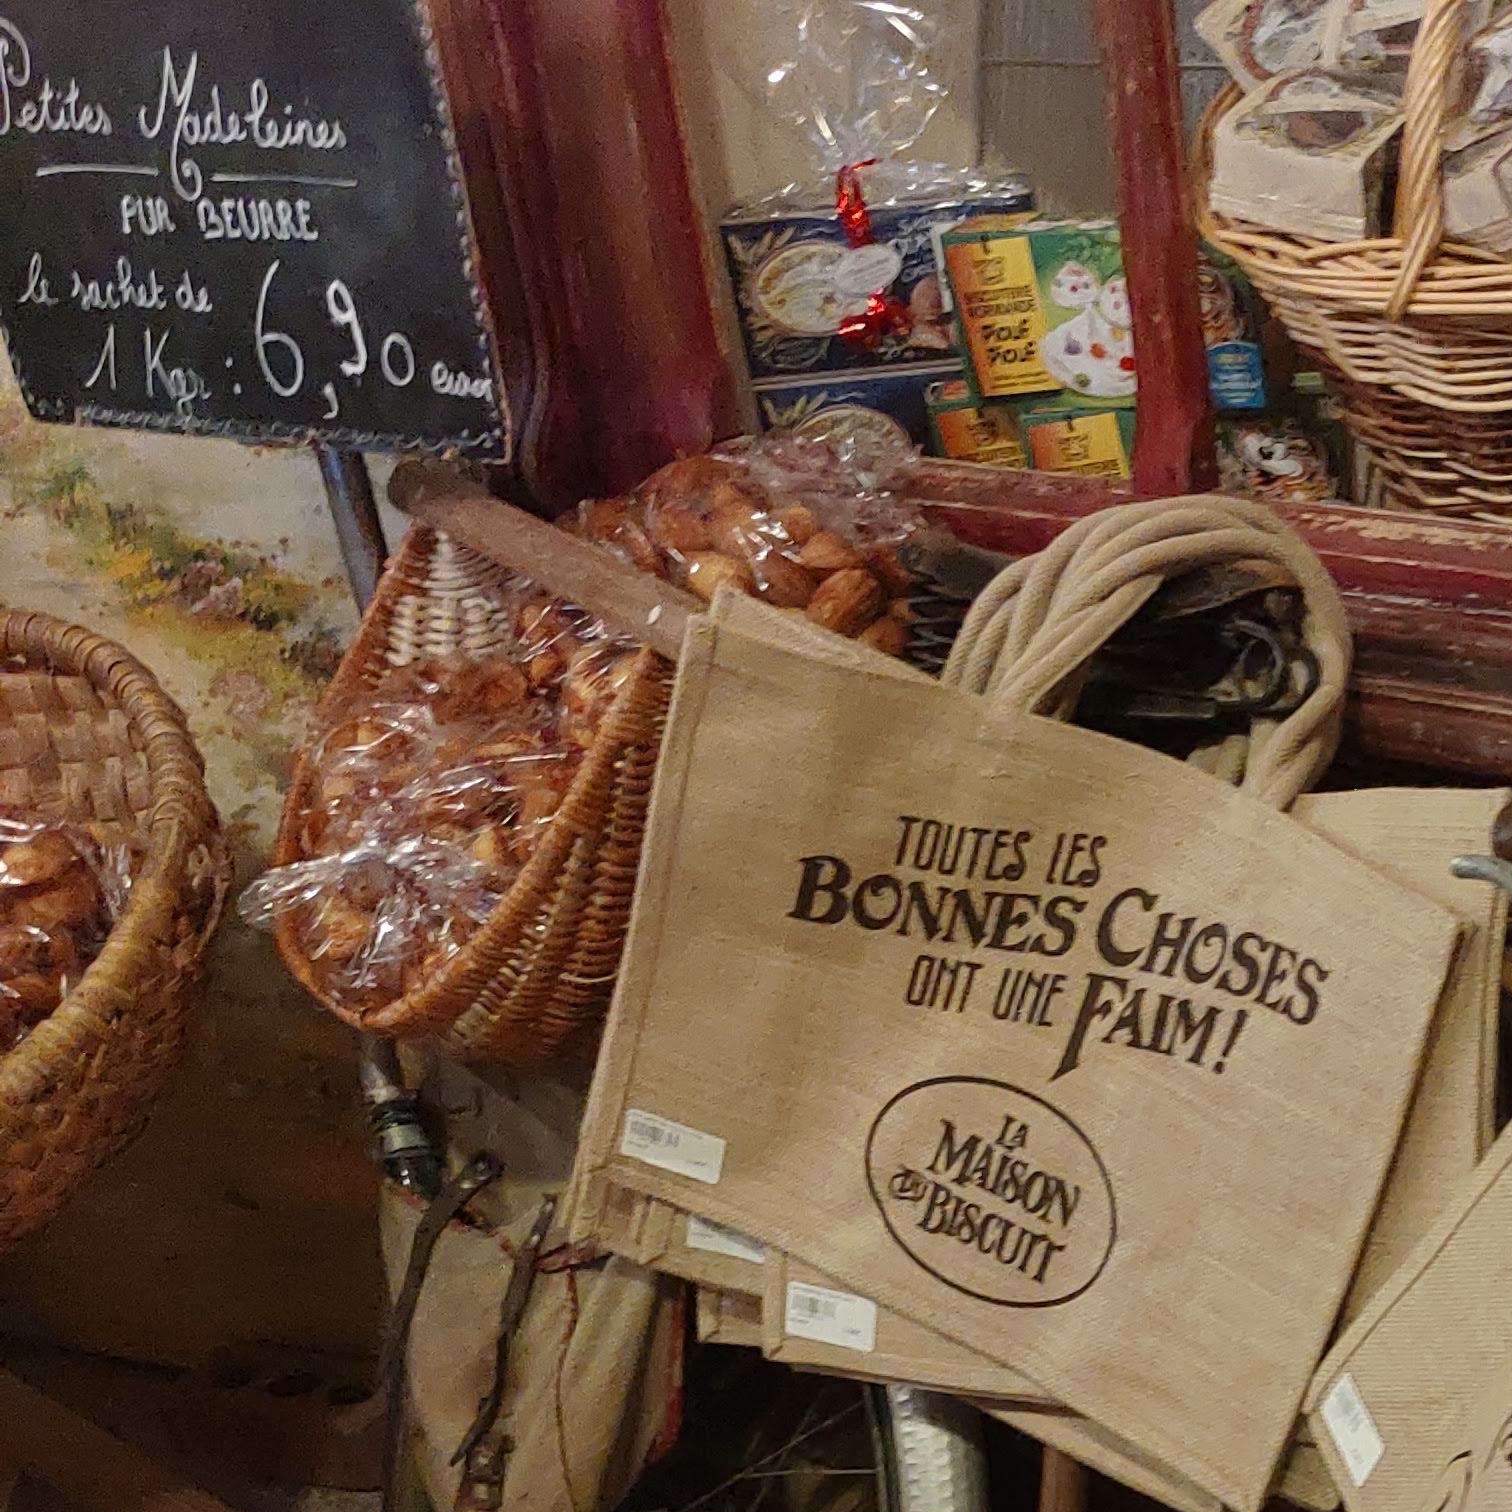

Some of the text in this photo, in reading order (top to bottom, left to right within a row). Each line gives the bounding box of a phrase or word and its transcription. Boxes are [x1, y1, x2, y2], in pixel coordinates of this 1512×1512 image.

[0, 17, 347, 200] Petites Madeleines
[121, 197, 319, 242] PUR BEURRE
[19, 252, 213, 313] le sachet de
[895, 815, 1108, 888] TOUTES LES
[786, 855, 1332, 1026] BONNES CHOSES
[905, 954, 1068, 1027] ONT UNE
[1049, 971, 1248, 1083] FAIM!
[926, 1117, 1081, 1228] MAISON
[995, 1114, 1029, 1151] LA
[916, 1180, 1067, 1284] BISCUIT
